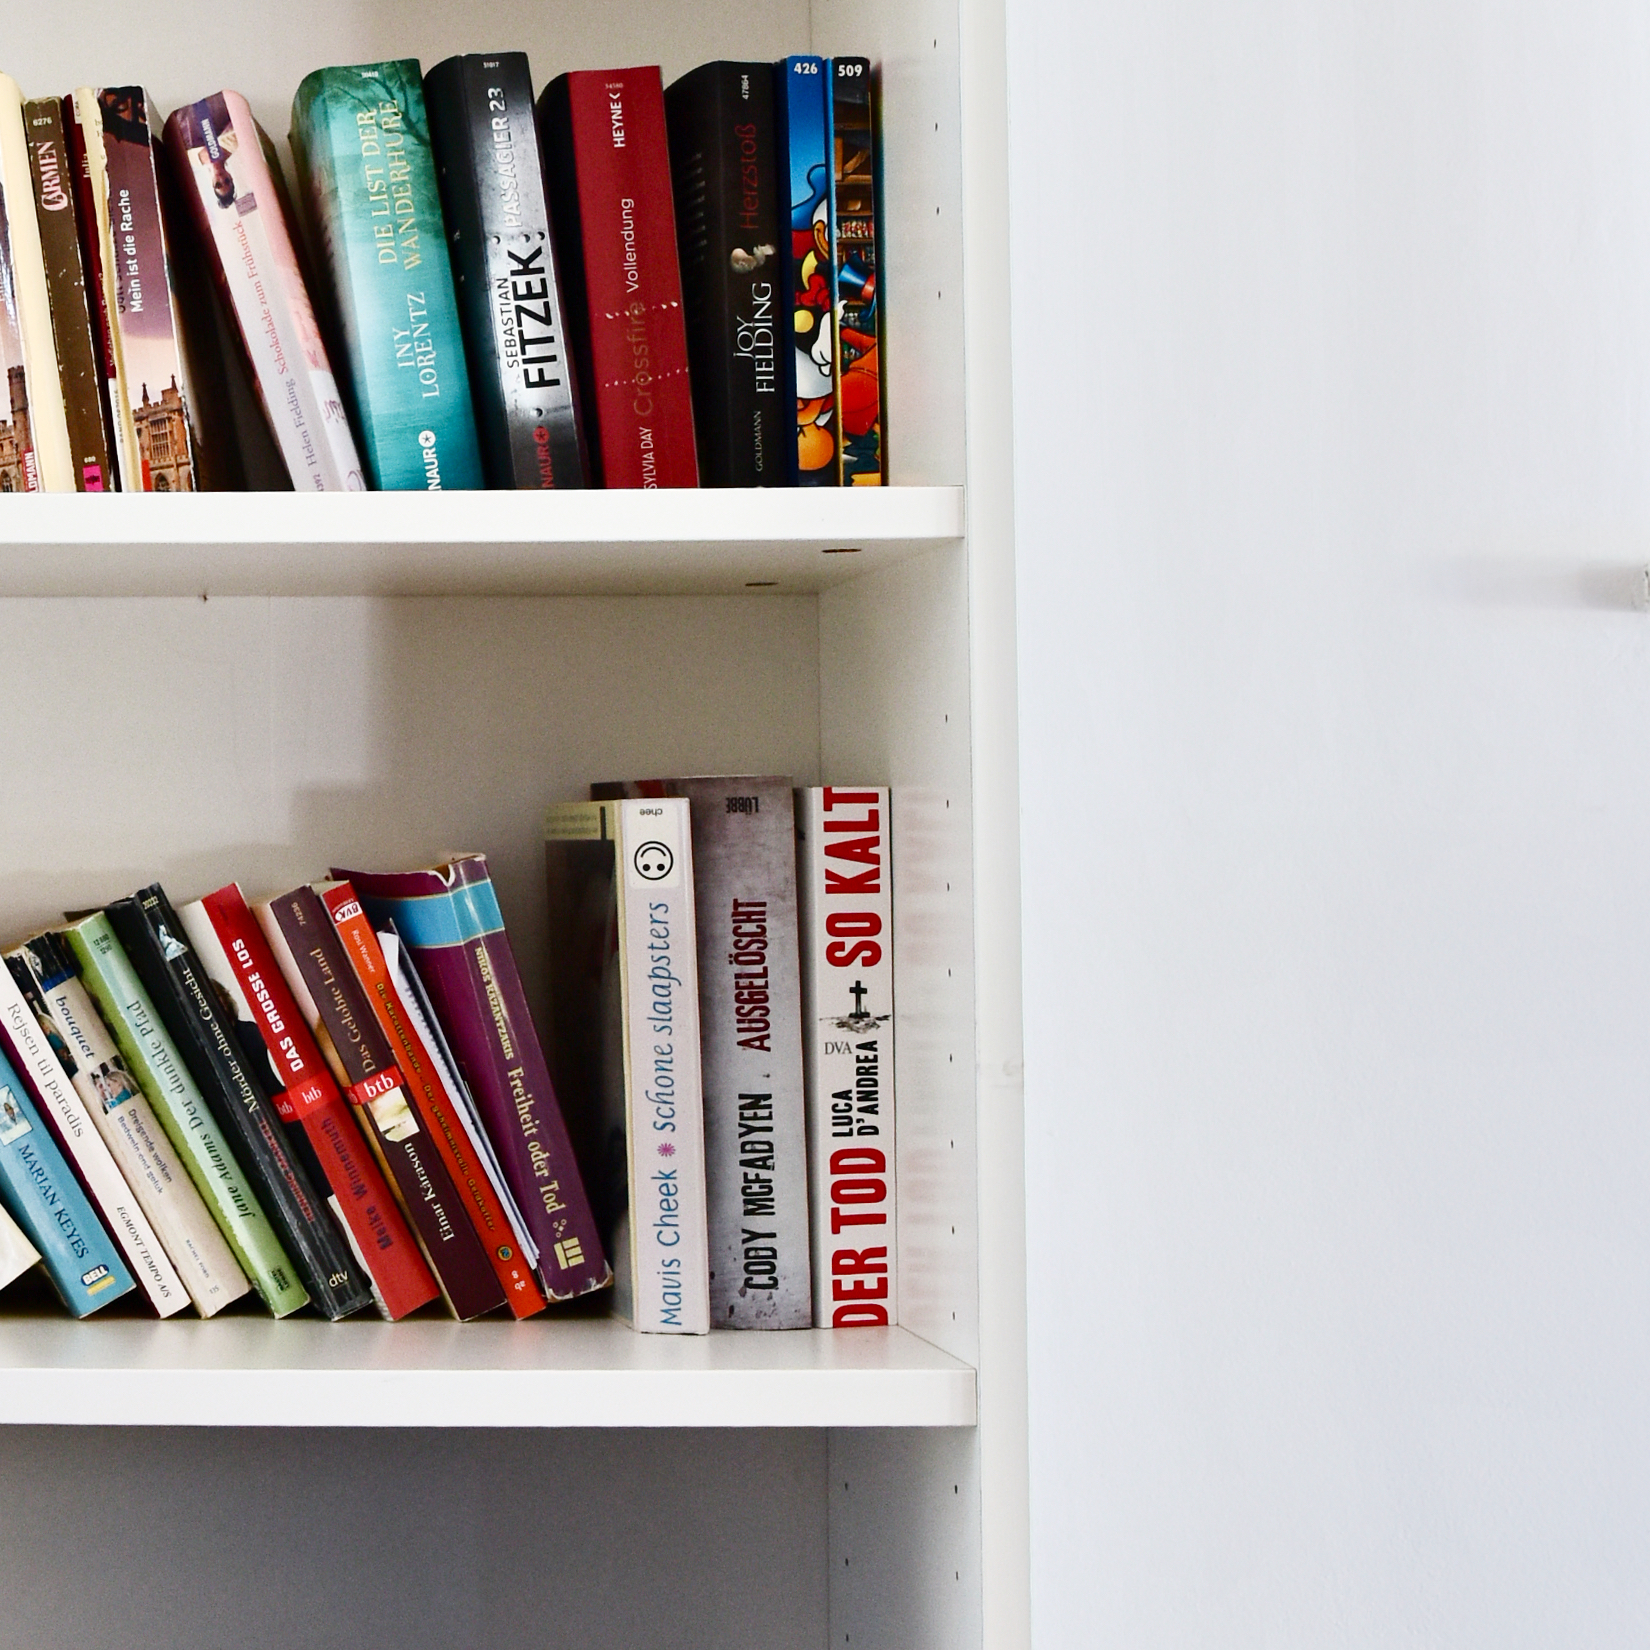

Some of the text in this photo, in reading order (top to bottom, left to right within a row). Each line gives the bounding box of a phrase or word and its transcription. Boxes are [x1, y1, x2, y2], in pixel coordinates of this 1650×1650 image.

[793, 63, 818, 75] 426
[838, 65, 863, 77] 509
[356, 108, 398, 264] DIE LIST DER
[379, 99, 423, 271] WANDERHURE
[620, 197, 640, 294] Vollendung
[396, 327, 415, 369] INY
[407, 291, 440, 399] LORENTZ
[493, 277, 519, 369] SEBASTIAN
[507, 247, 560, 390] FITZEK
[734, 315, 756, 360] JOY
[752, 281, 776, 394] FIELDING
[232, 938, 304, 1071] DAS GROSSE LOS
[304, 1087, 322, 1105] btb
[365, 1074, 395, 1099] btb
[727, 898, 778, 1290] CODY MCFADYEN AUSGELÖSCHT
[824, 787, 888, 1327] DER TOD SO KALT
[857, 1040, 880, 1136] D'ANDREA
[507, 1066, 565, 1214] Freiheit oder Tod
[831, 1088, 854, 1138] LUCA
[19, 1144, 89, 1260] MARIAN KEYES
[83, 1267, 107, 1284] BELL
[329, 1270, 348, 1287] dtv
